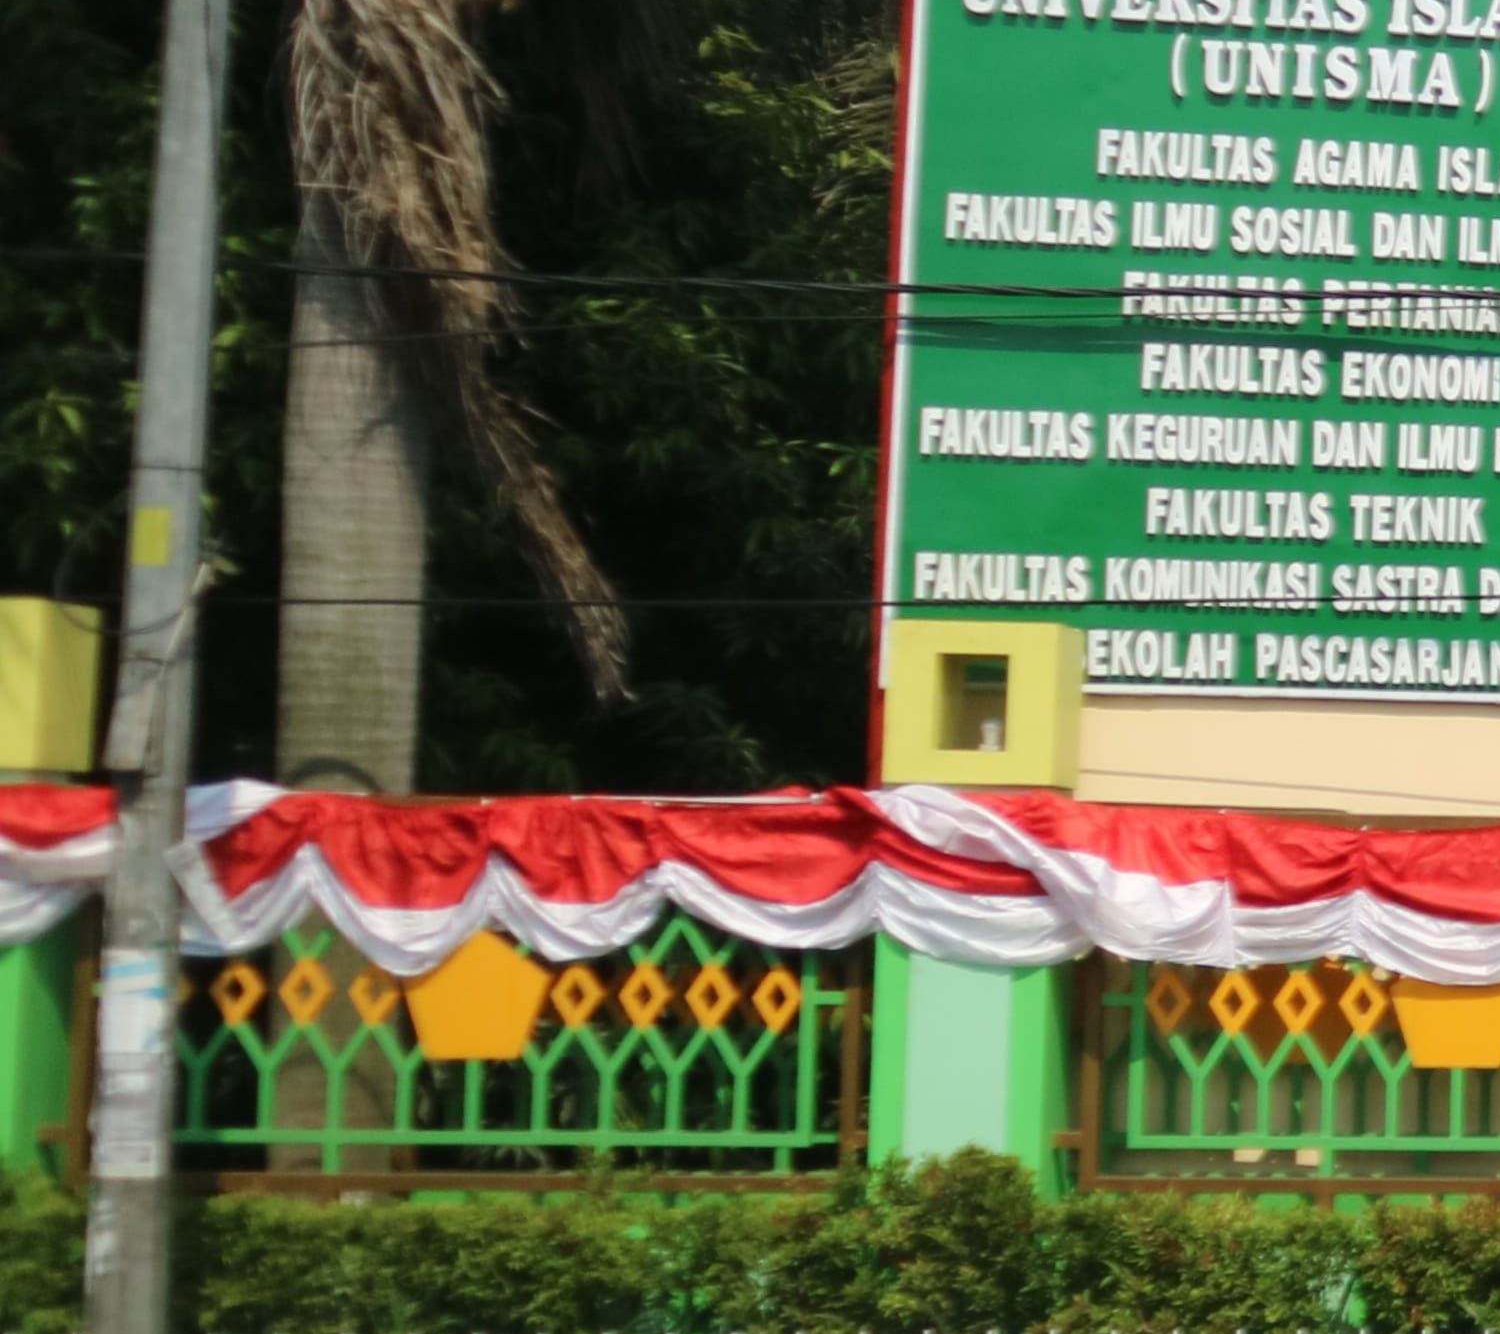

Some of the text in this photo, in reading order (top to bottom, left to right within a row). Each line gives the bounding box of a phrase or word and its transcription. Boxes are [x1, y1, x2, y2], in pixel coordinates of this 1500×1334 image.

[1097, 128, 1275, 184] FAKULTAS
[1293, 139, 1419, 191] AGAMA
[945, 192, 1115, 247] FAKULTAS
[1132, 201, 1215, 252] ILMU
[1230, 205, 1355, 257] SOSIAL
[1372, 212, 1443, 261] DAN
[1122, 271, 1305, 325] FAKULTAS
[1140, 343, 1325, 397] FAKULTAS
[919, 408, 1092, 460] FAKULTAS
[1106, 415, 1299, 468] KEGURUAN
[1312, 422, 1386, 470] DAN
[1398, 426, 1482, 474] ILMU
[1146, 488, 1485, 545] FAKULTAS TEKNIK
[914, 554, 1091, 603] FAKULTAS
[1105, 558, 1322, 610] KOMUNIKASI
[1331, 565, 1464, 614] SASTRA
[1084, 629, 1236, 679] EKOLAH
